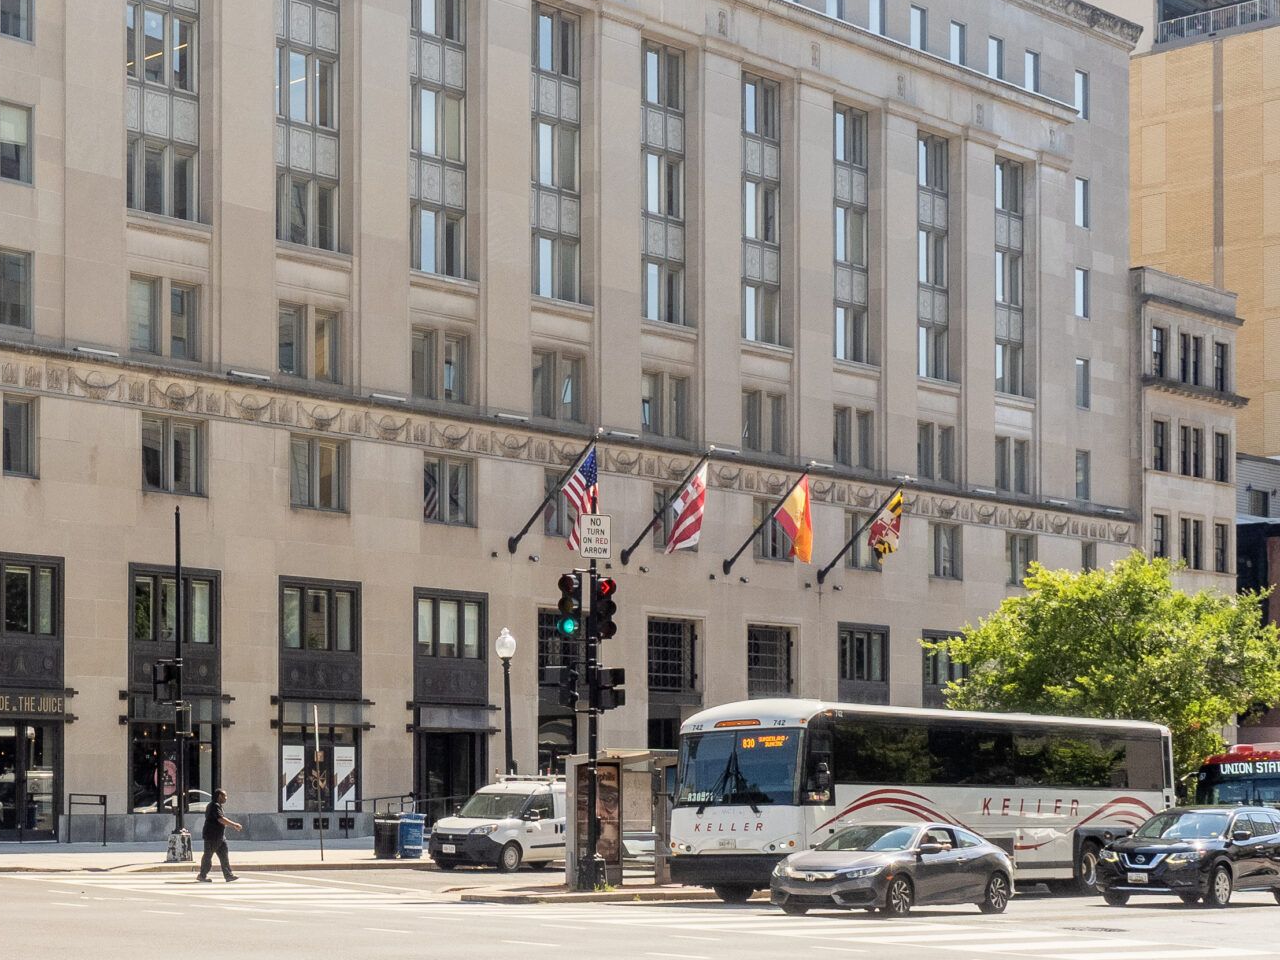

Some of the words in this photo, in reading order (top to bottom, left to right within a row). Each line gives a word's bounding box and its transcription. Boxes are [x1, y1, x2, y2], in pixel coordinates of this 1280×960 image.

[590, 518, 601, 526] NO
[595, 537, 609, 545] RED
[18, 696, 36, 712] THE
[37, 697, 63, 713] JUICE
[742, 738, 755, 749] 830
[1220, 762, 1253, 775] UNION
[982, 797, 1080, 817] KELLER
[694, 823, 764, 832] KELLER
